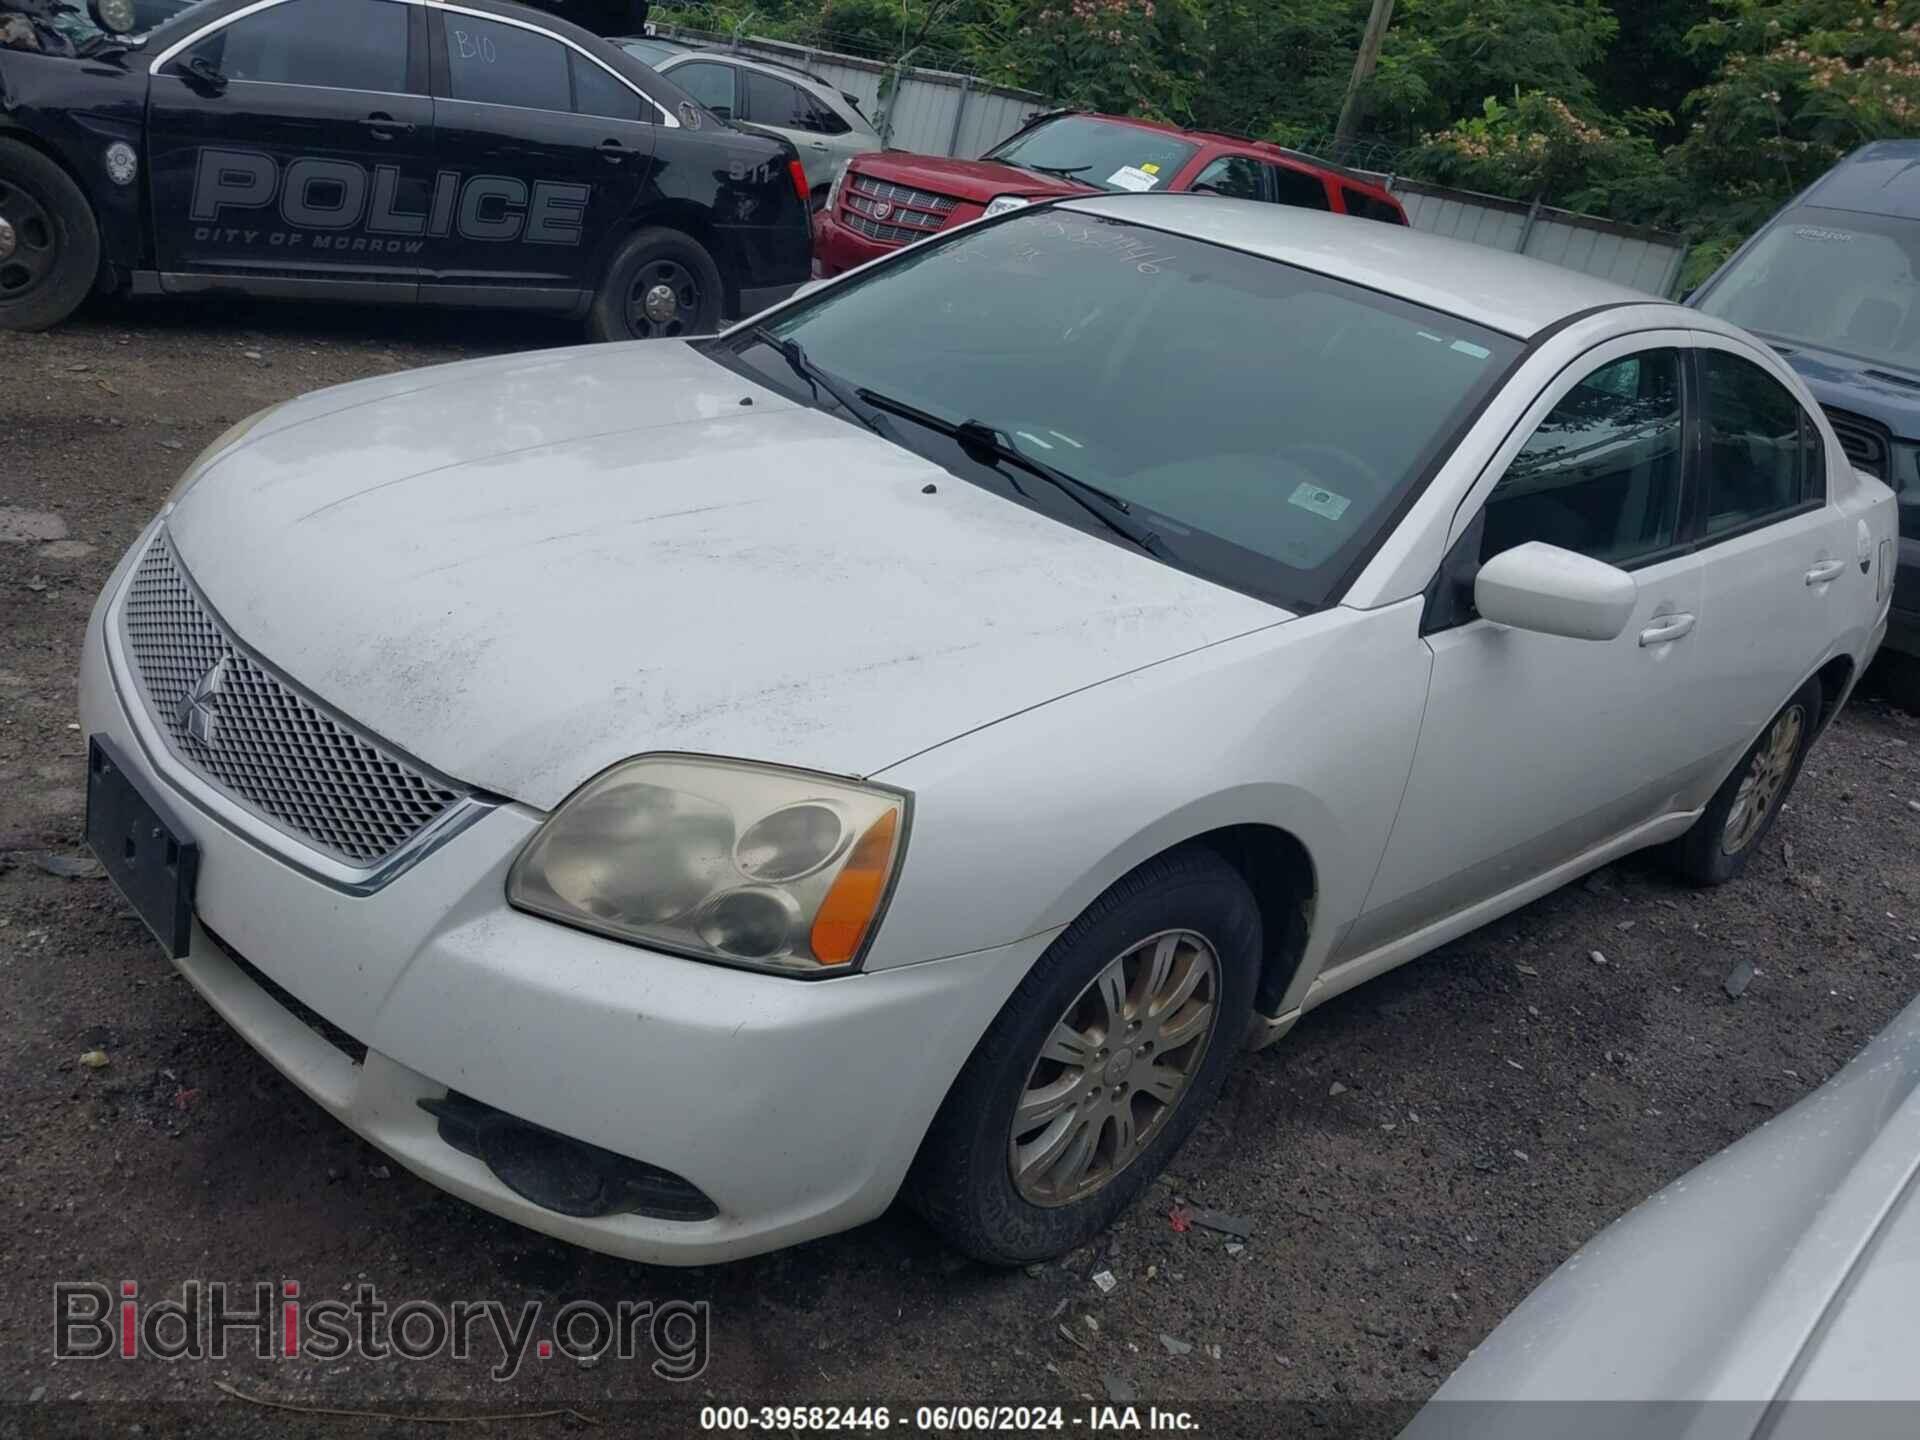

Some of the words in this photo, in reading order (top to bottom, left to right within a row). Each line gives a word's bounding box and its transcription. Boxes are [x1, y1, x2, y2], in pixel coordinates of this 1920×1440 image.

[729, 160, 770, 184] 911
[189, 146, 592, 247] POLICE
[194, 227, 259, 244] CITY
[268, 231, 303, 247] OF
[312, 235, 425, 253] MORROW
